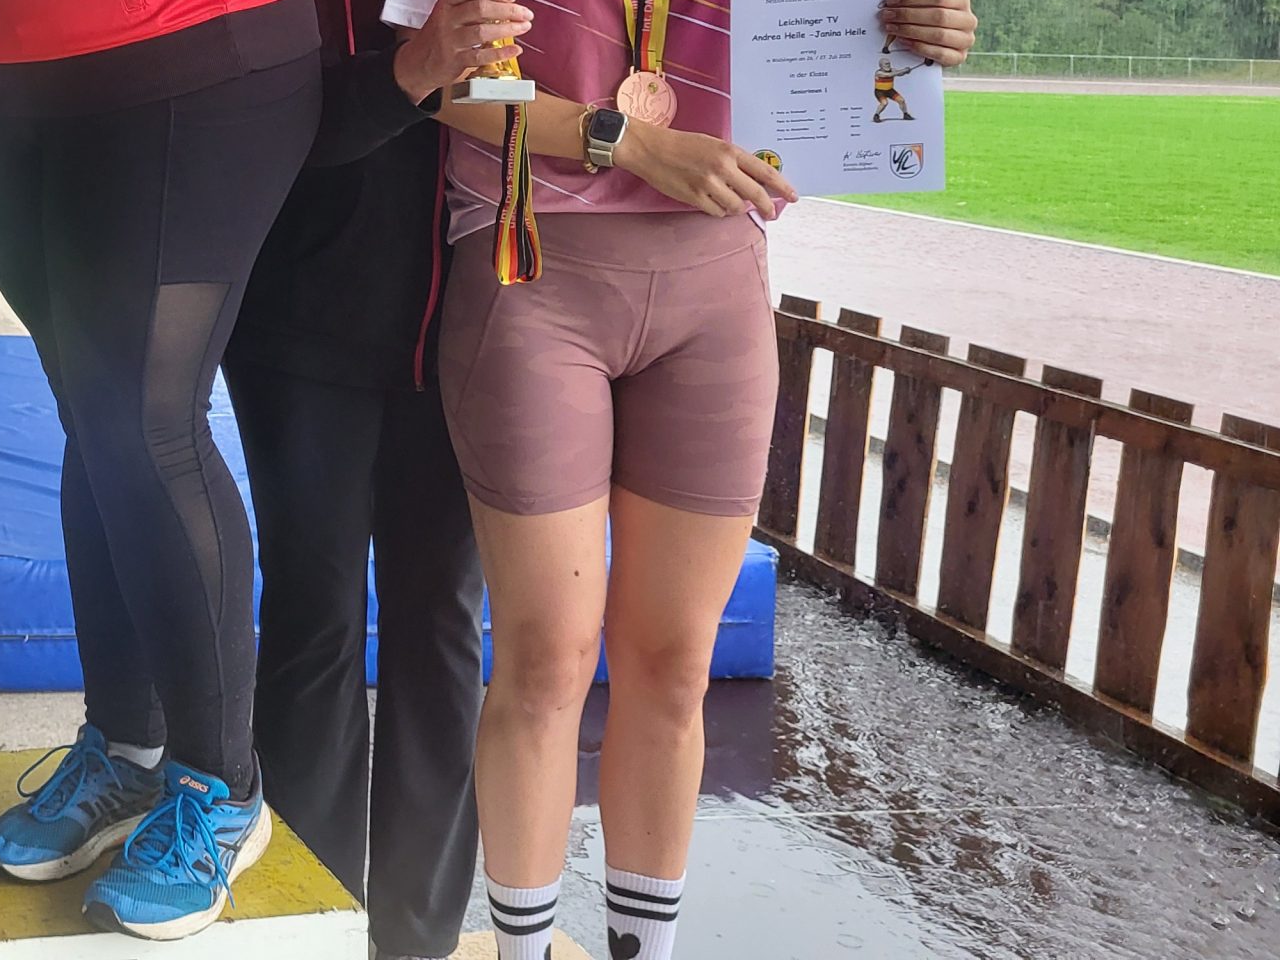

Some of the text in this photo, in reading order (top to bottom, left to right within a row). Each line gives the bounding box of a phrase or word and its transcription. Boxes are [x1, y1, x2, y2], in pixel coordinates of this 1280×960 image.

[642, 14, 651, 32] Int.
[779, 18, 823, 26] Leichlinger
[507, 116, 520, 181] Seniorinnen
[506, 185, 513, 205] DM
